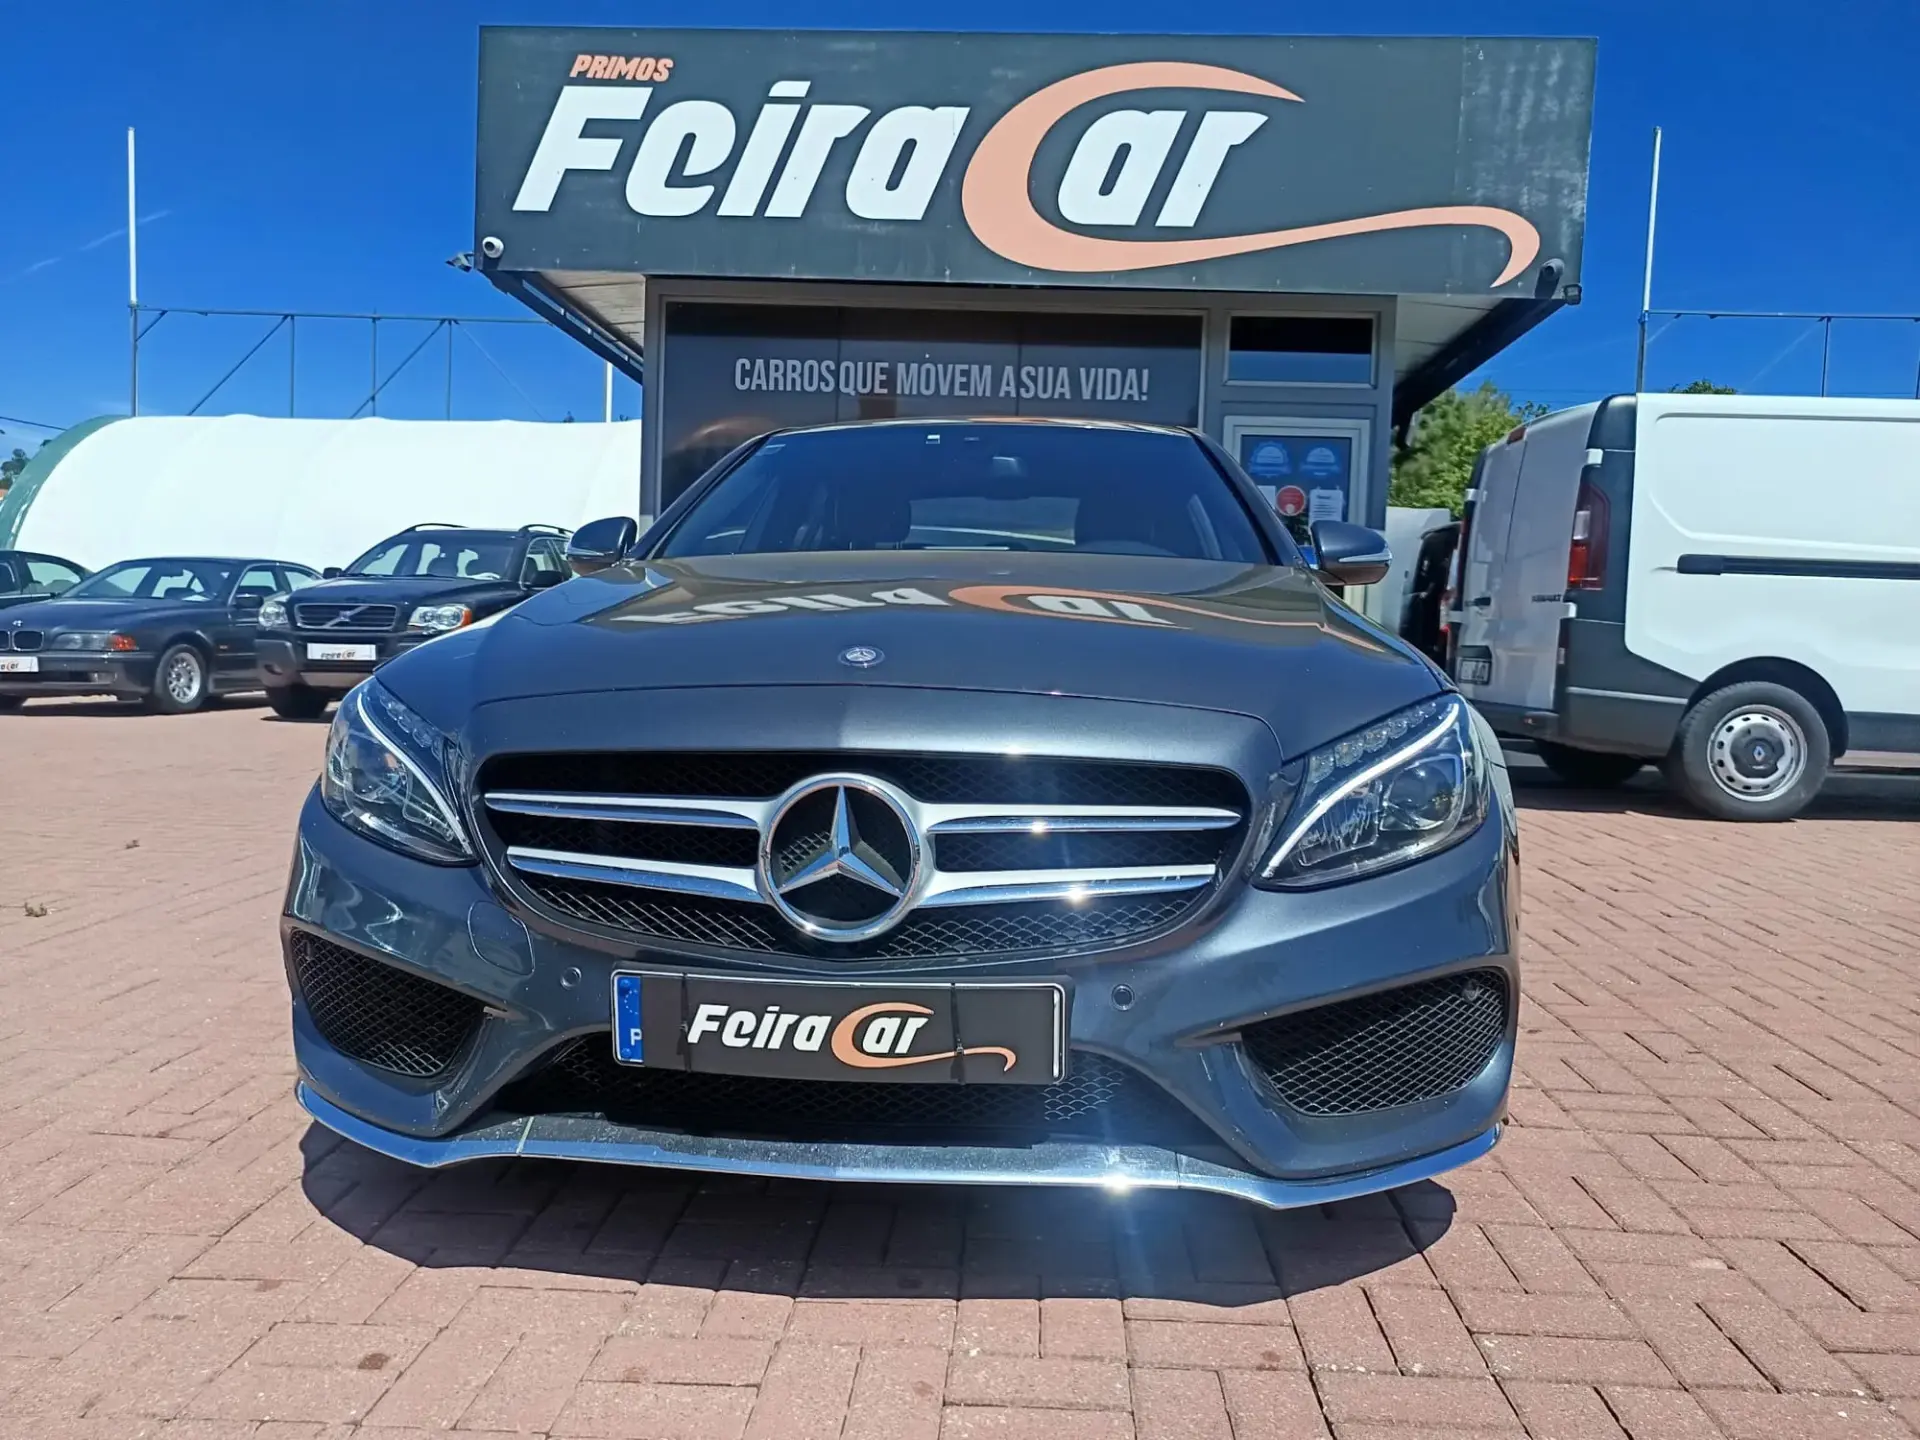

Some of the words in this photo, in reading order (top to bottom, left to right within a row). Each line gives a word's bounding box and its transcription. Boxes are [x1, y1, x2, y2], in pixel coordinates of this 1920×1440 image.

[570, 53, 674, 83] PRIMOS
[734, 357, 835, 393] CARROS
[838, 360, 890, 396] QUE
[1019, 366, 1072, 400] SUA
[1079, 367, 1149, 401] VIDA!
